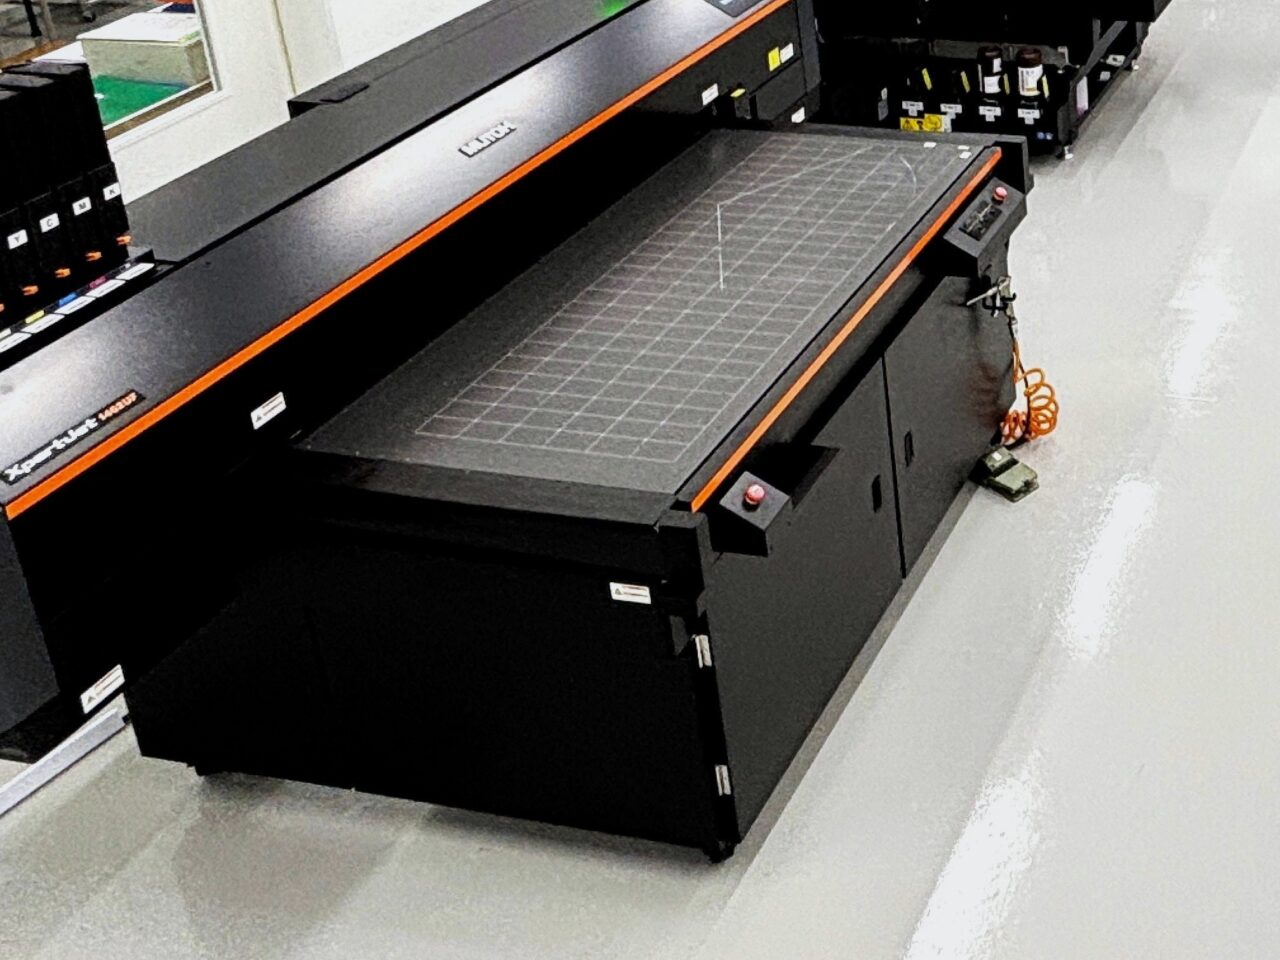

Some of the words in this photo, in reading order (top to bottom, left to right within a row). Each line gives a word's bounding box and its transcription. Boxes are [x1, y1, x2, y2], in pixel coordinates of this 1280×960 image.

[459, 120, 517, 157] MUTOH
[78, 202, 87, 210] M
[4, 418, 98, 481] XpertJet
